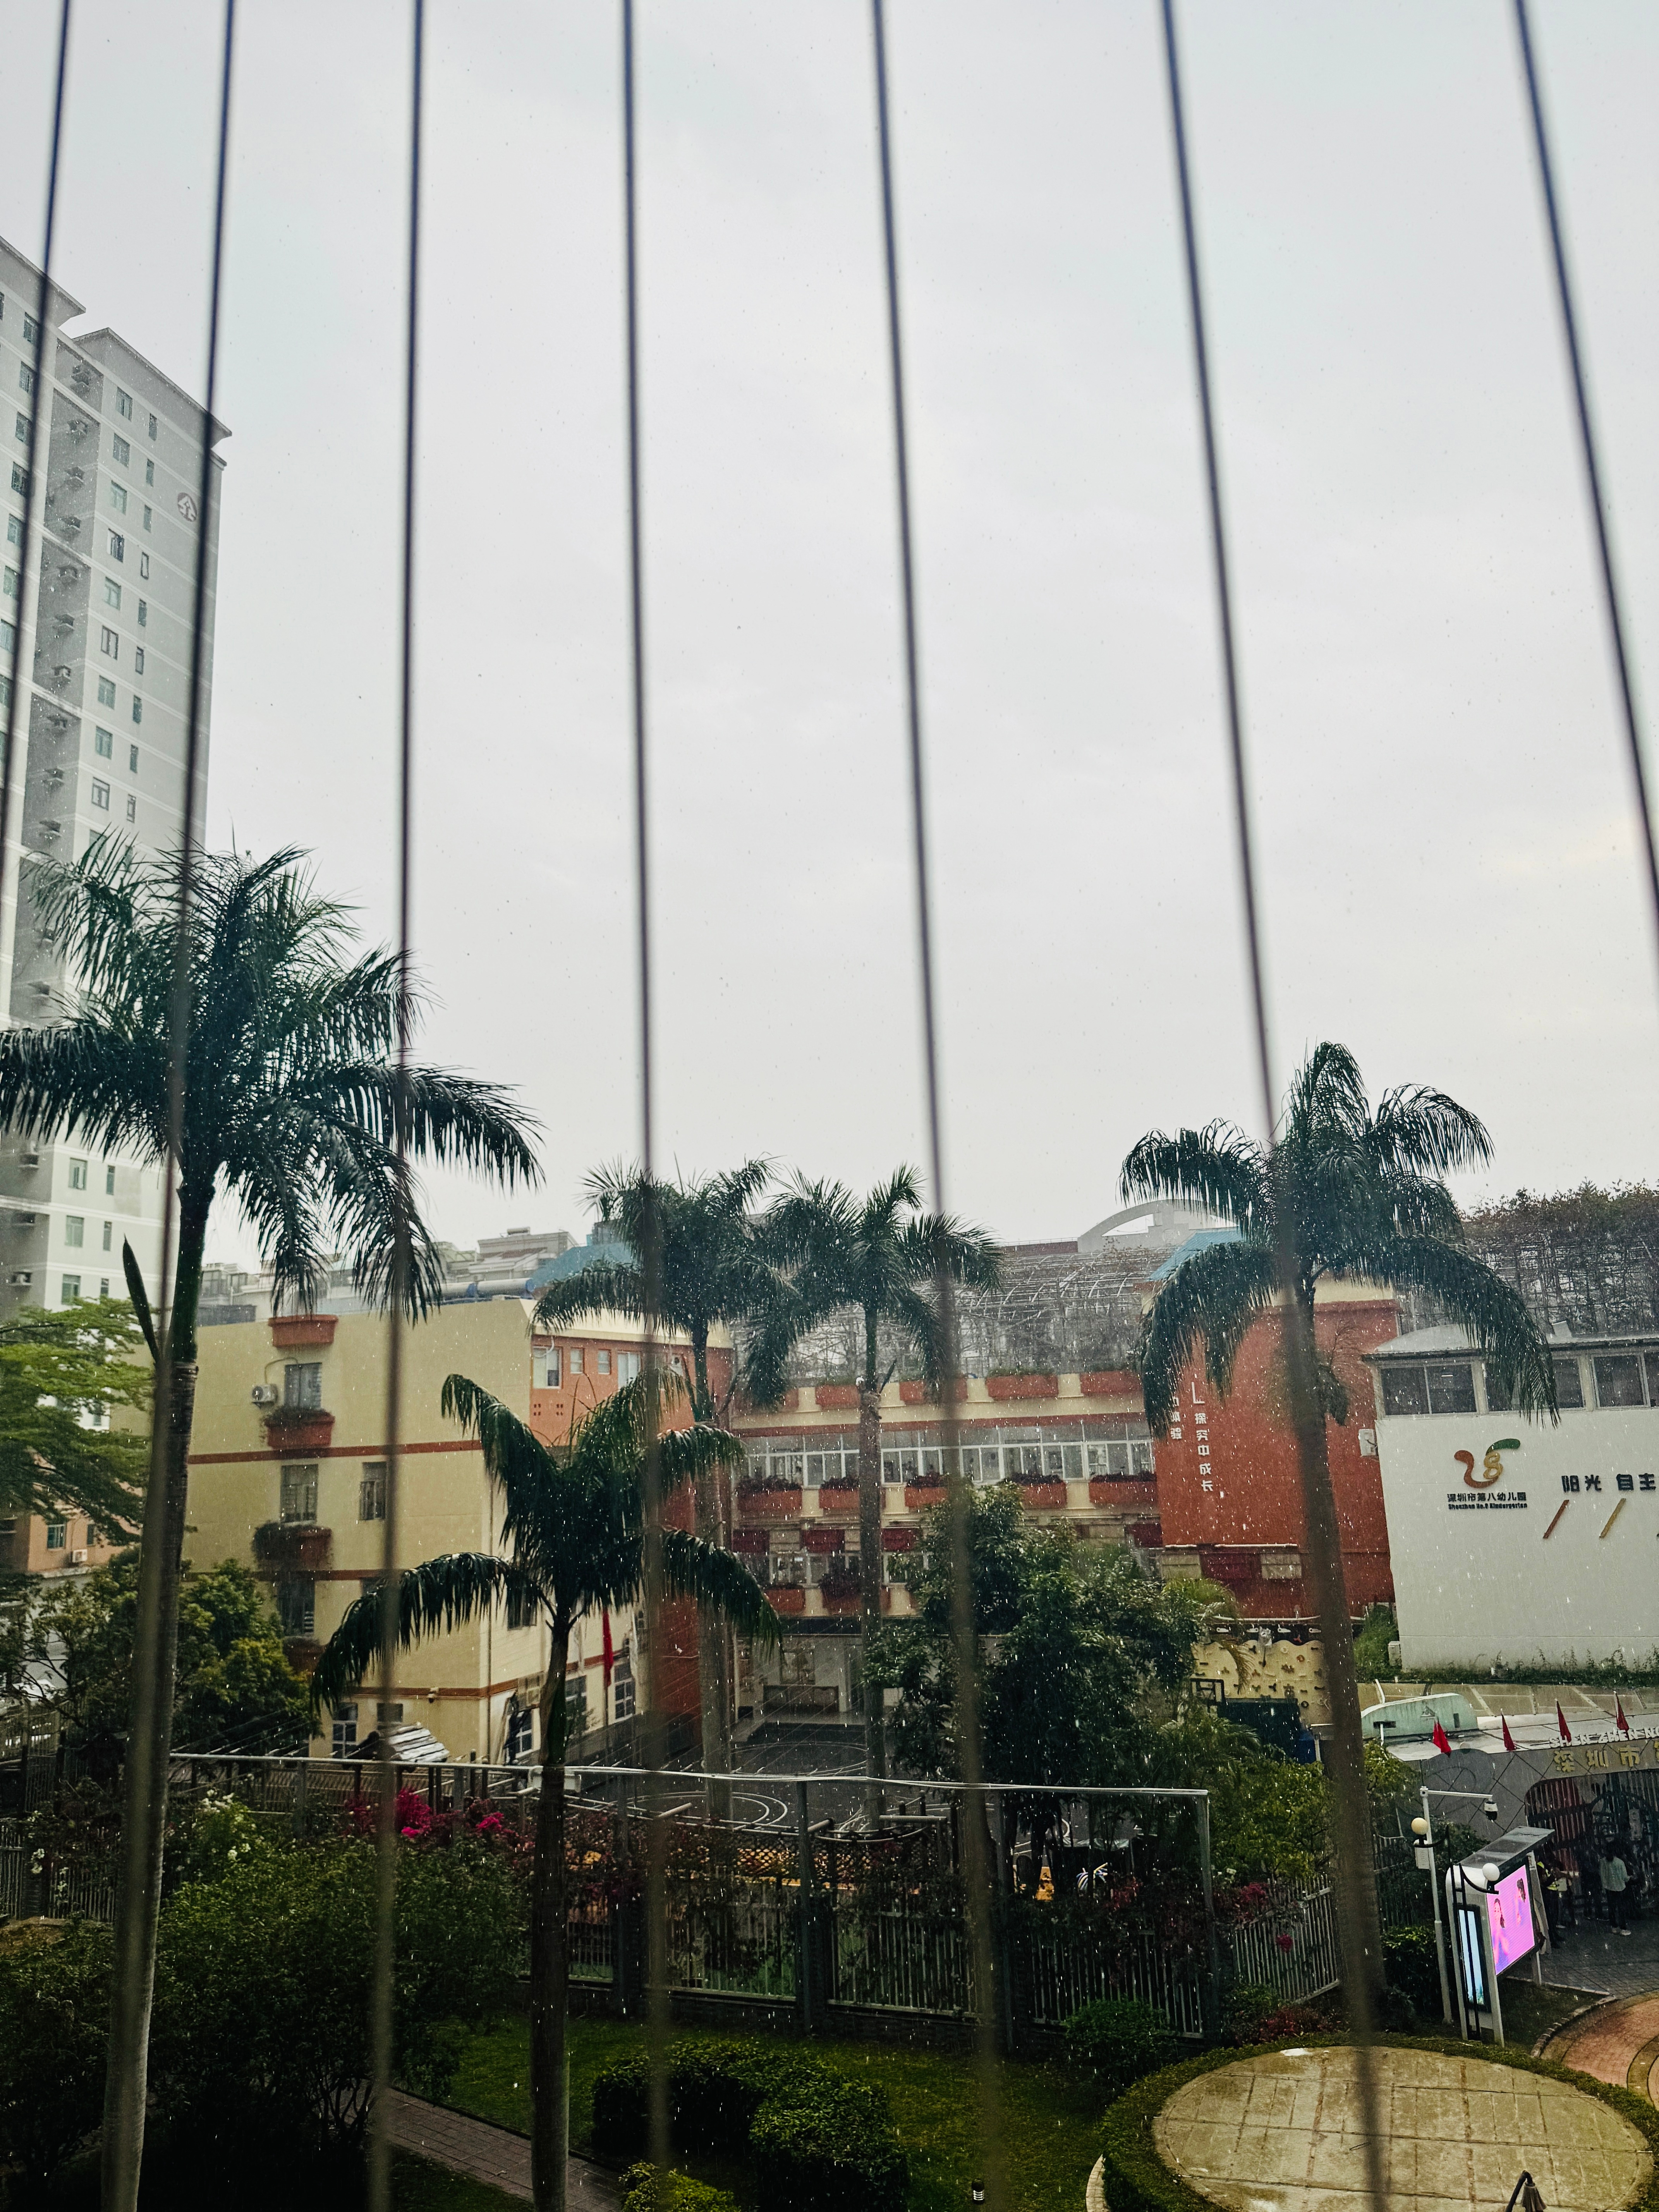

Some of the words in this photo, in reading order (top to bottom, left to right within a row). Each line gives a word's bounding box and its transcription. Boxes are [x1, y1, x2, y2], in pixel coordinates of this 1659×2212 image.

[1194, 1413, 1213, 1492] 探究中成长
[1561, 1474, 1602, 1492] 阳光
[1616, 1473, 1656, 1491] 自主
[1447, 1492, 1527, 1502] 深圳市第八幼儿园
[1554, 1740, 1659, 1772] 深圳市
